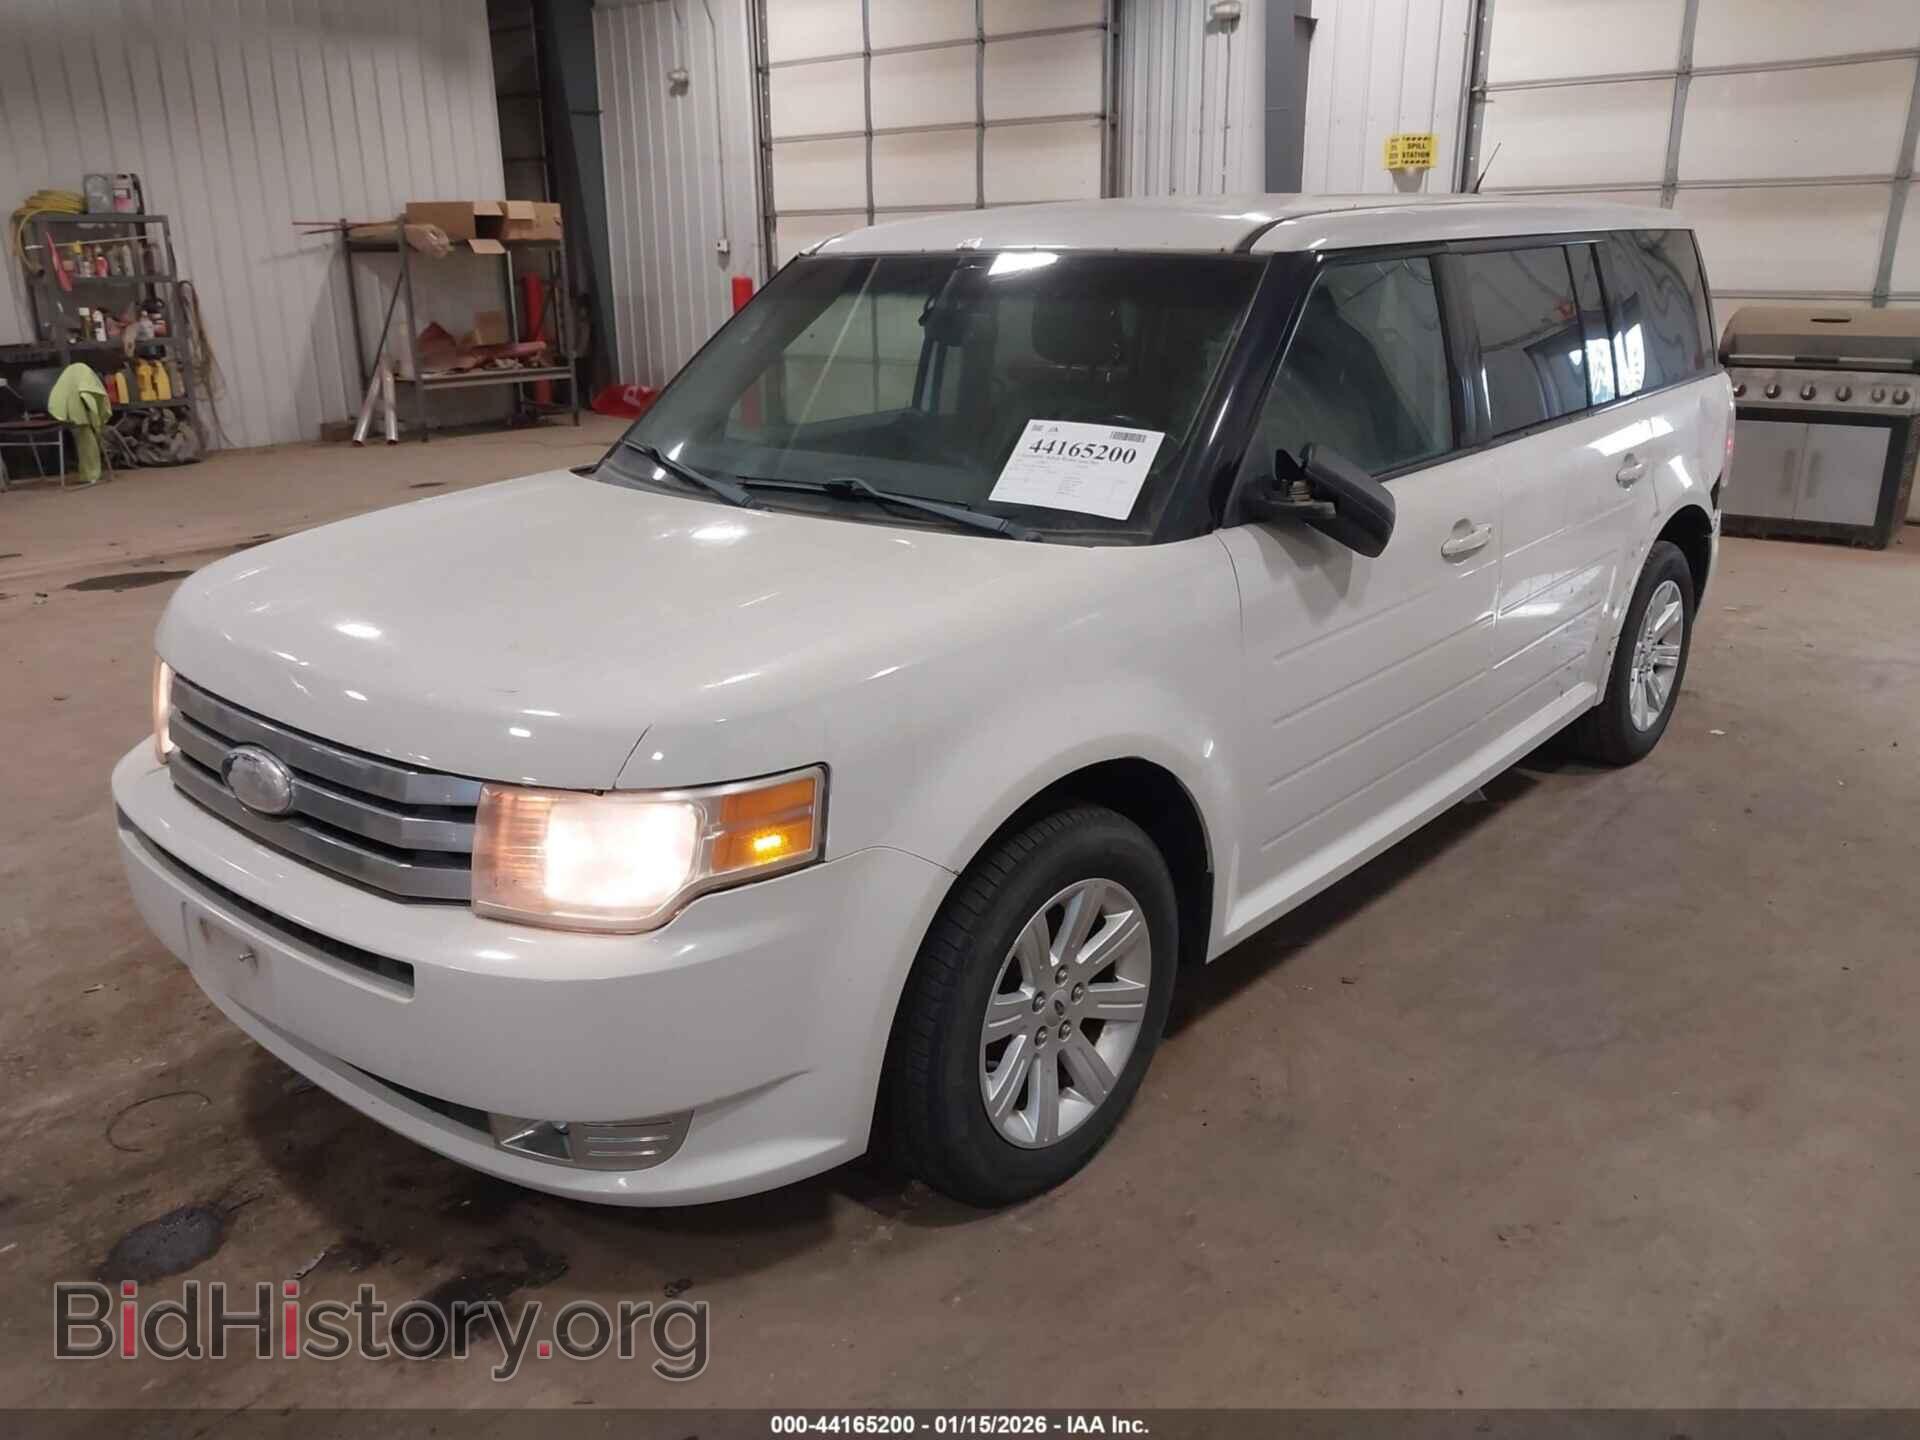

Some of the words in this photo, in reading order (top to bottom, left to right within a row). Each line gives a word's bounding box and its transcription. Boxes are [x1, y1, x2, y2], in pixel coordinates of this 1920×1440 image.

[1407, 142, 1425, 150] SPILL
[1402, 151, 1430, 159] STATION
[1029, 437, 1138, 465] 44165200
